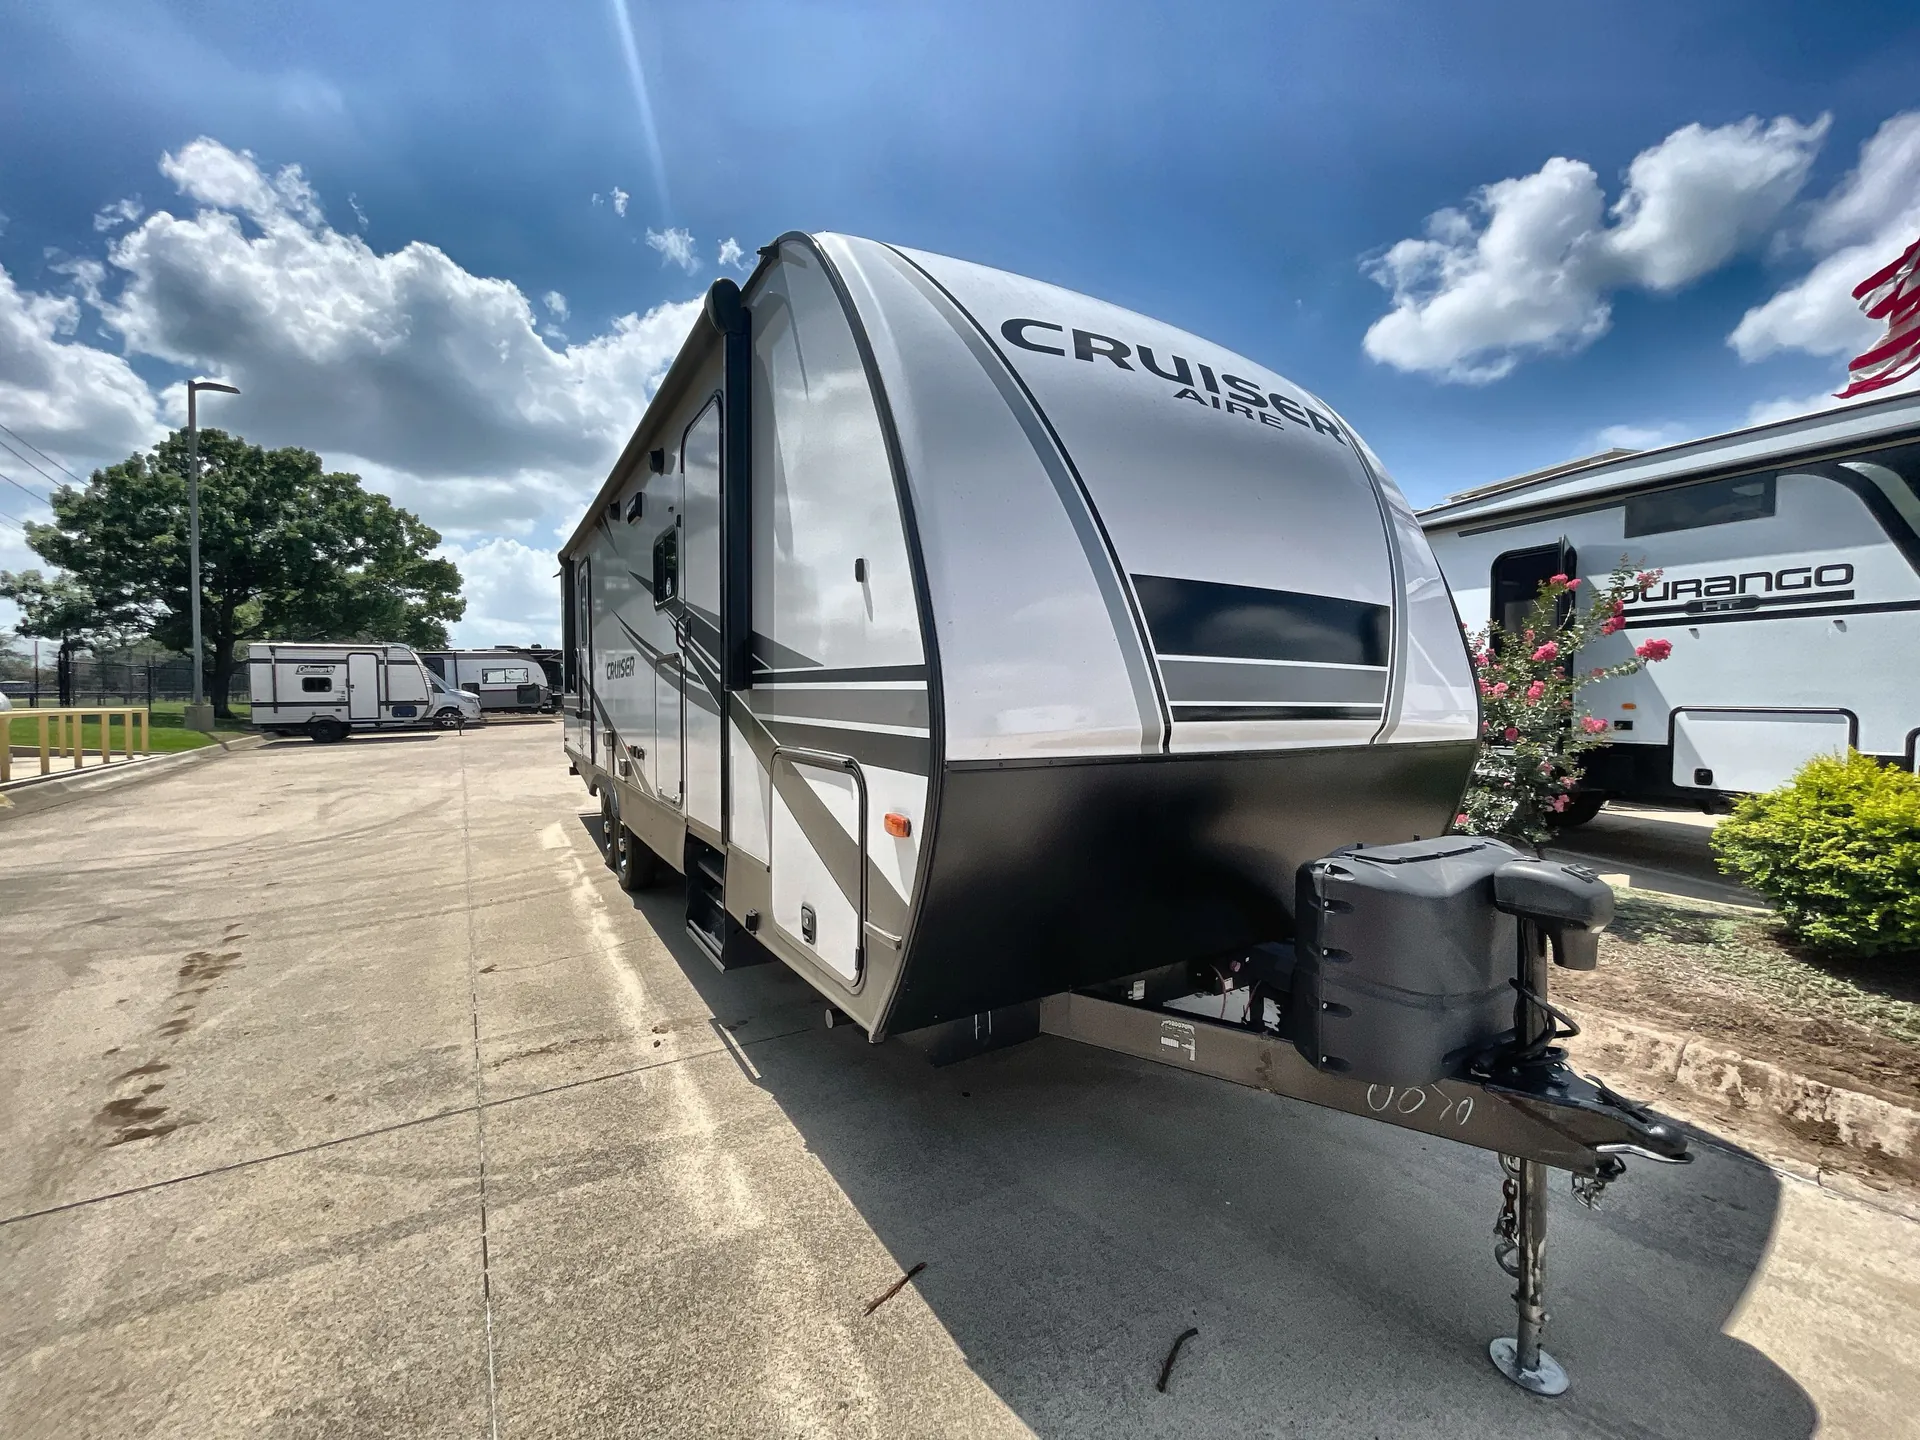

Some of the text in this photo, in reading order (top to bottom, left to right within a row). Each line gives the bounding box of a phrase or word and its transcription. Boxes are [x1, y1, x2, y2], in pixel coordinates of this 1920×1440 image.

[1000, 318, 1347, 446] CRUISER
[1173, 388, 1285, 431] AIRE
[607, 656, 635, 680] CRUISER
